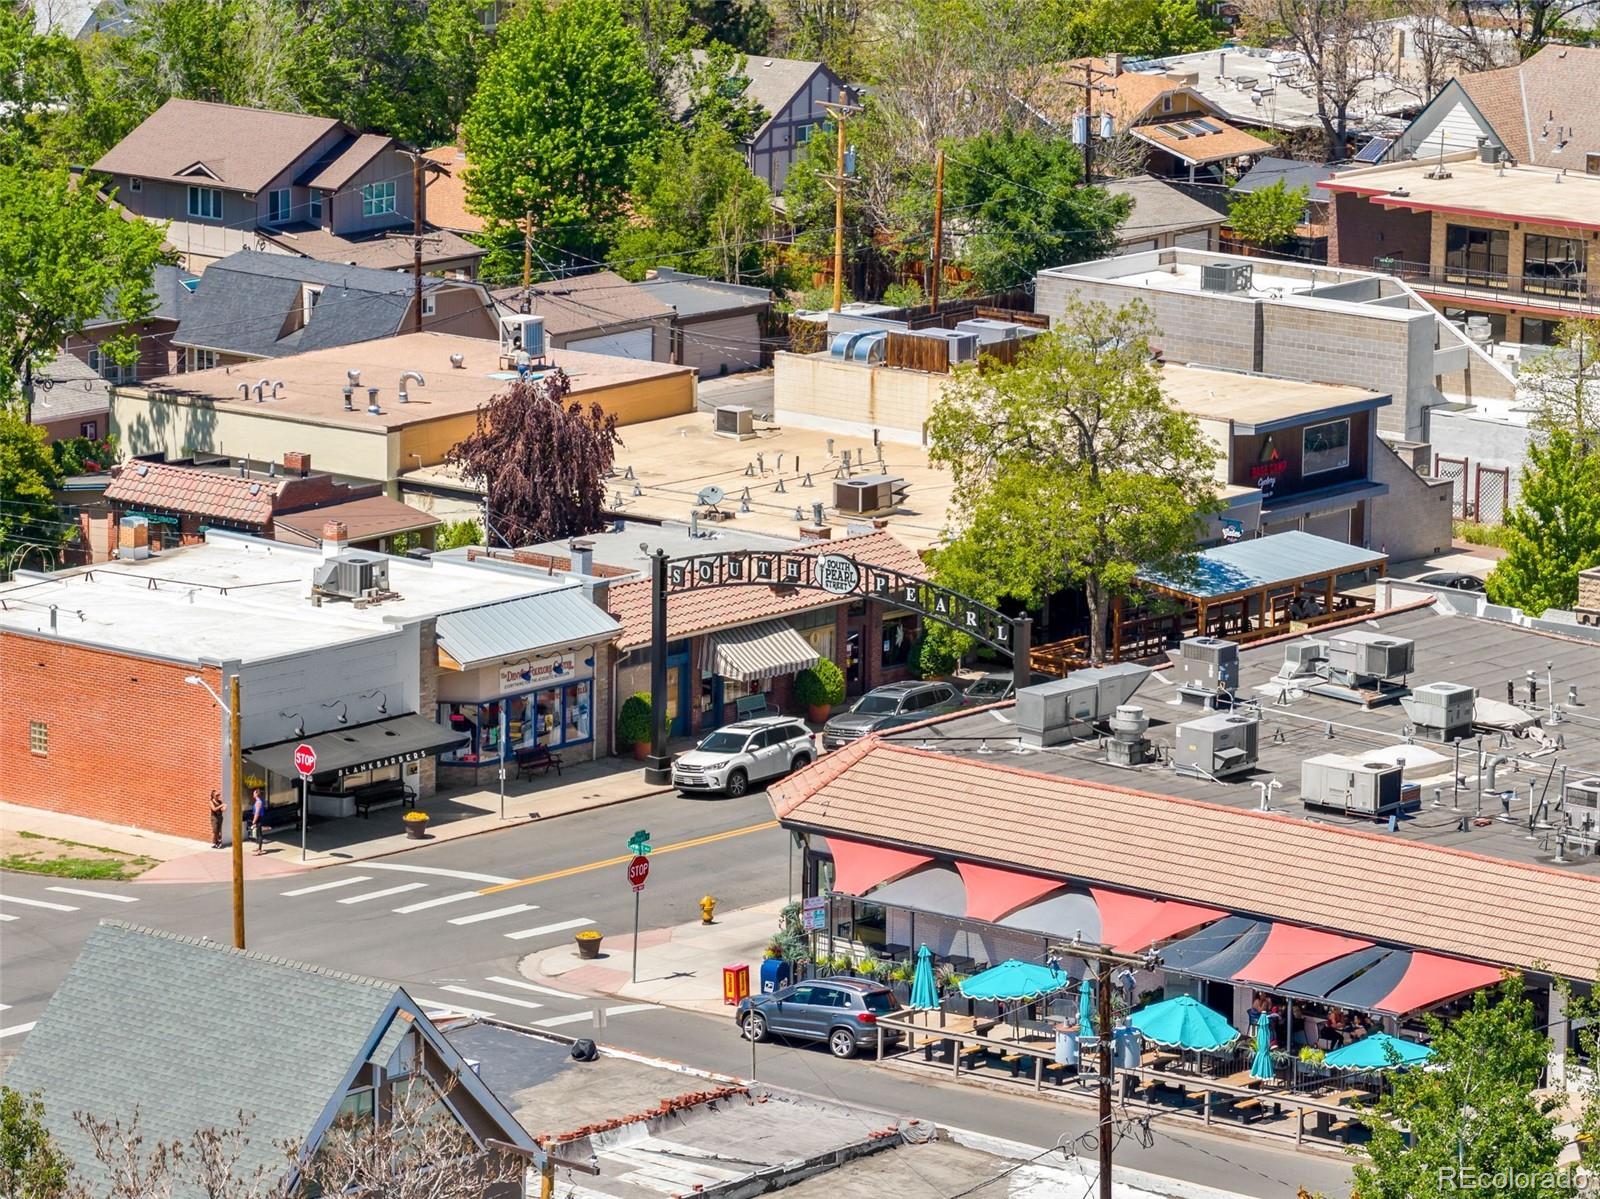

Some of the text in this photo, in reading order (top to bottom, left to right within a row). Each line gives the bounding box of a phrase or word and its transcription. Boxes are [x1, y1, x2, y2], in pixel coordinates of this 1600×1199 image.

[827, 560, 851, 571] SOUTH
[825, 568, 856, 586] PEARL
[825, 580, 848, 590] STREET
[671, 559, 1008, 641] SOUTH PEARL
[296, 752, 314, 767] STOP
[338, 750, 427, 777] BLANKBARBERS
[630, 863, 648, 878] STOP
